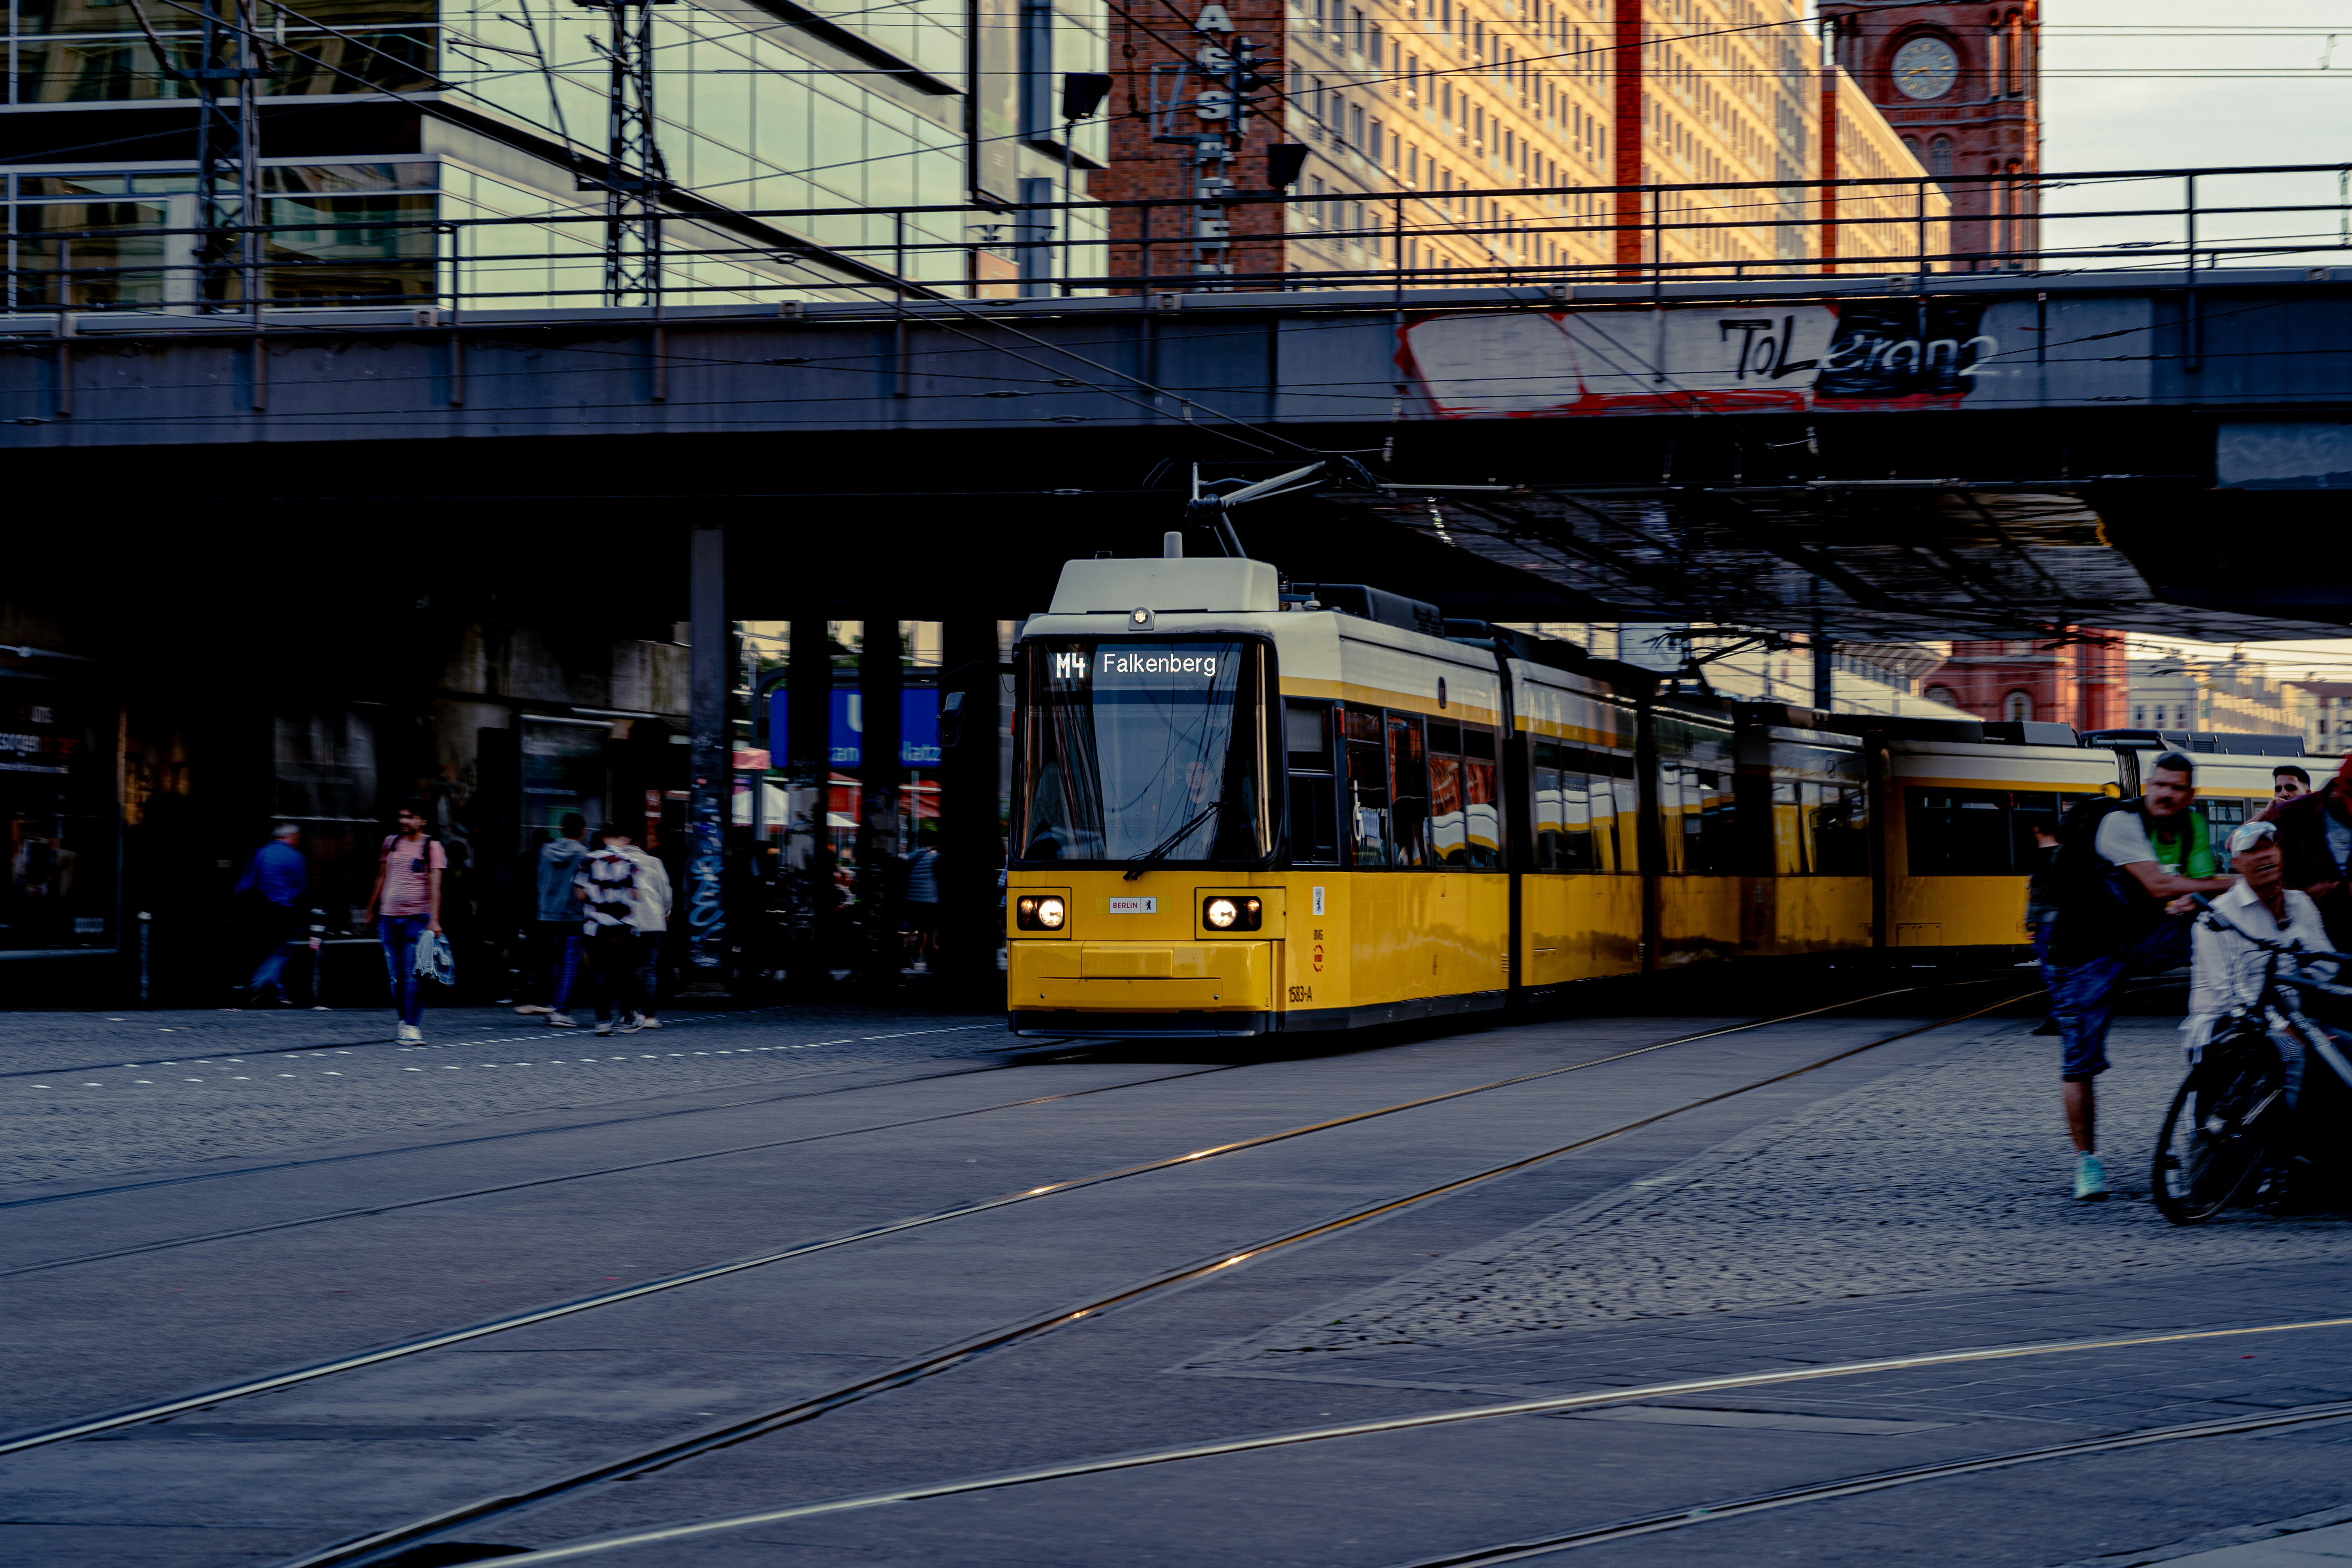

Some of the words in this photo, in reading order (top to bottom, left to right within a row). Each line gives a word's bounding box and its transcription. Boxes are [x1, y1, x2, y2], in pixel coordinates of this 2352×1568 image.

[1056, 653, 1086, 678] M4
[1104, 653, 1216, 677] Falkenberg
[1314, 930, 1323, 940] BVG
[1289, 986, 1313, 1003] 1583-A
